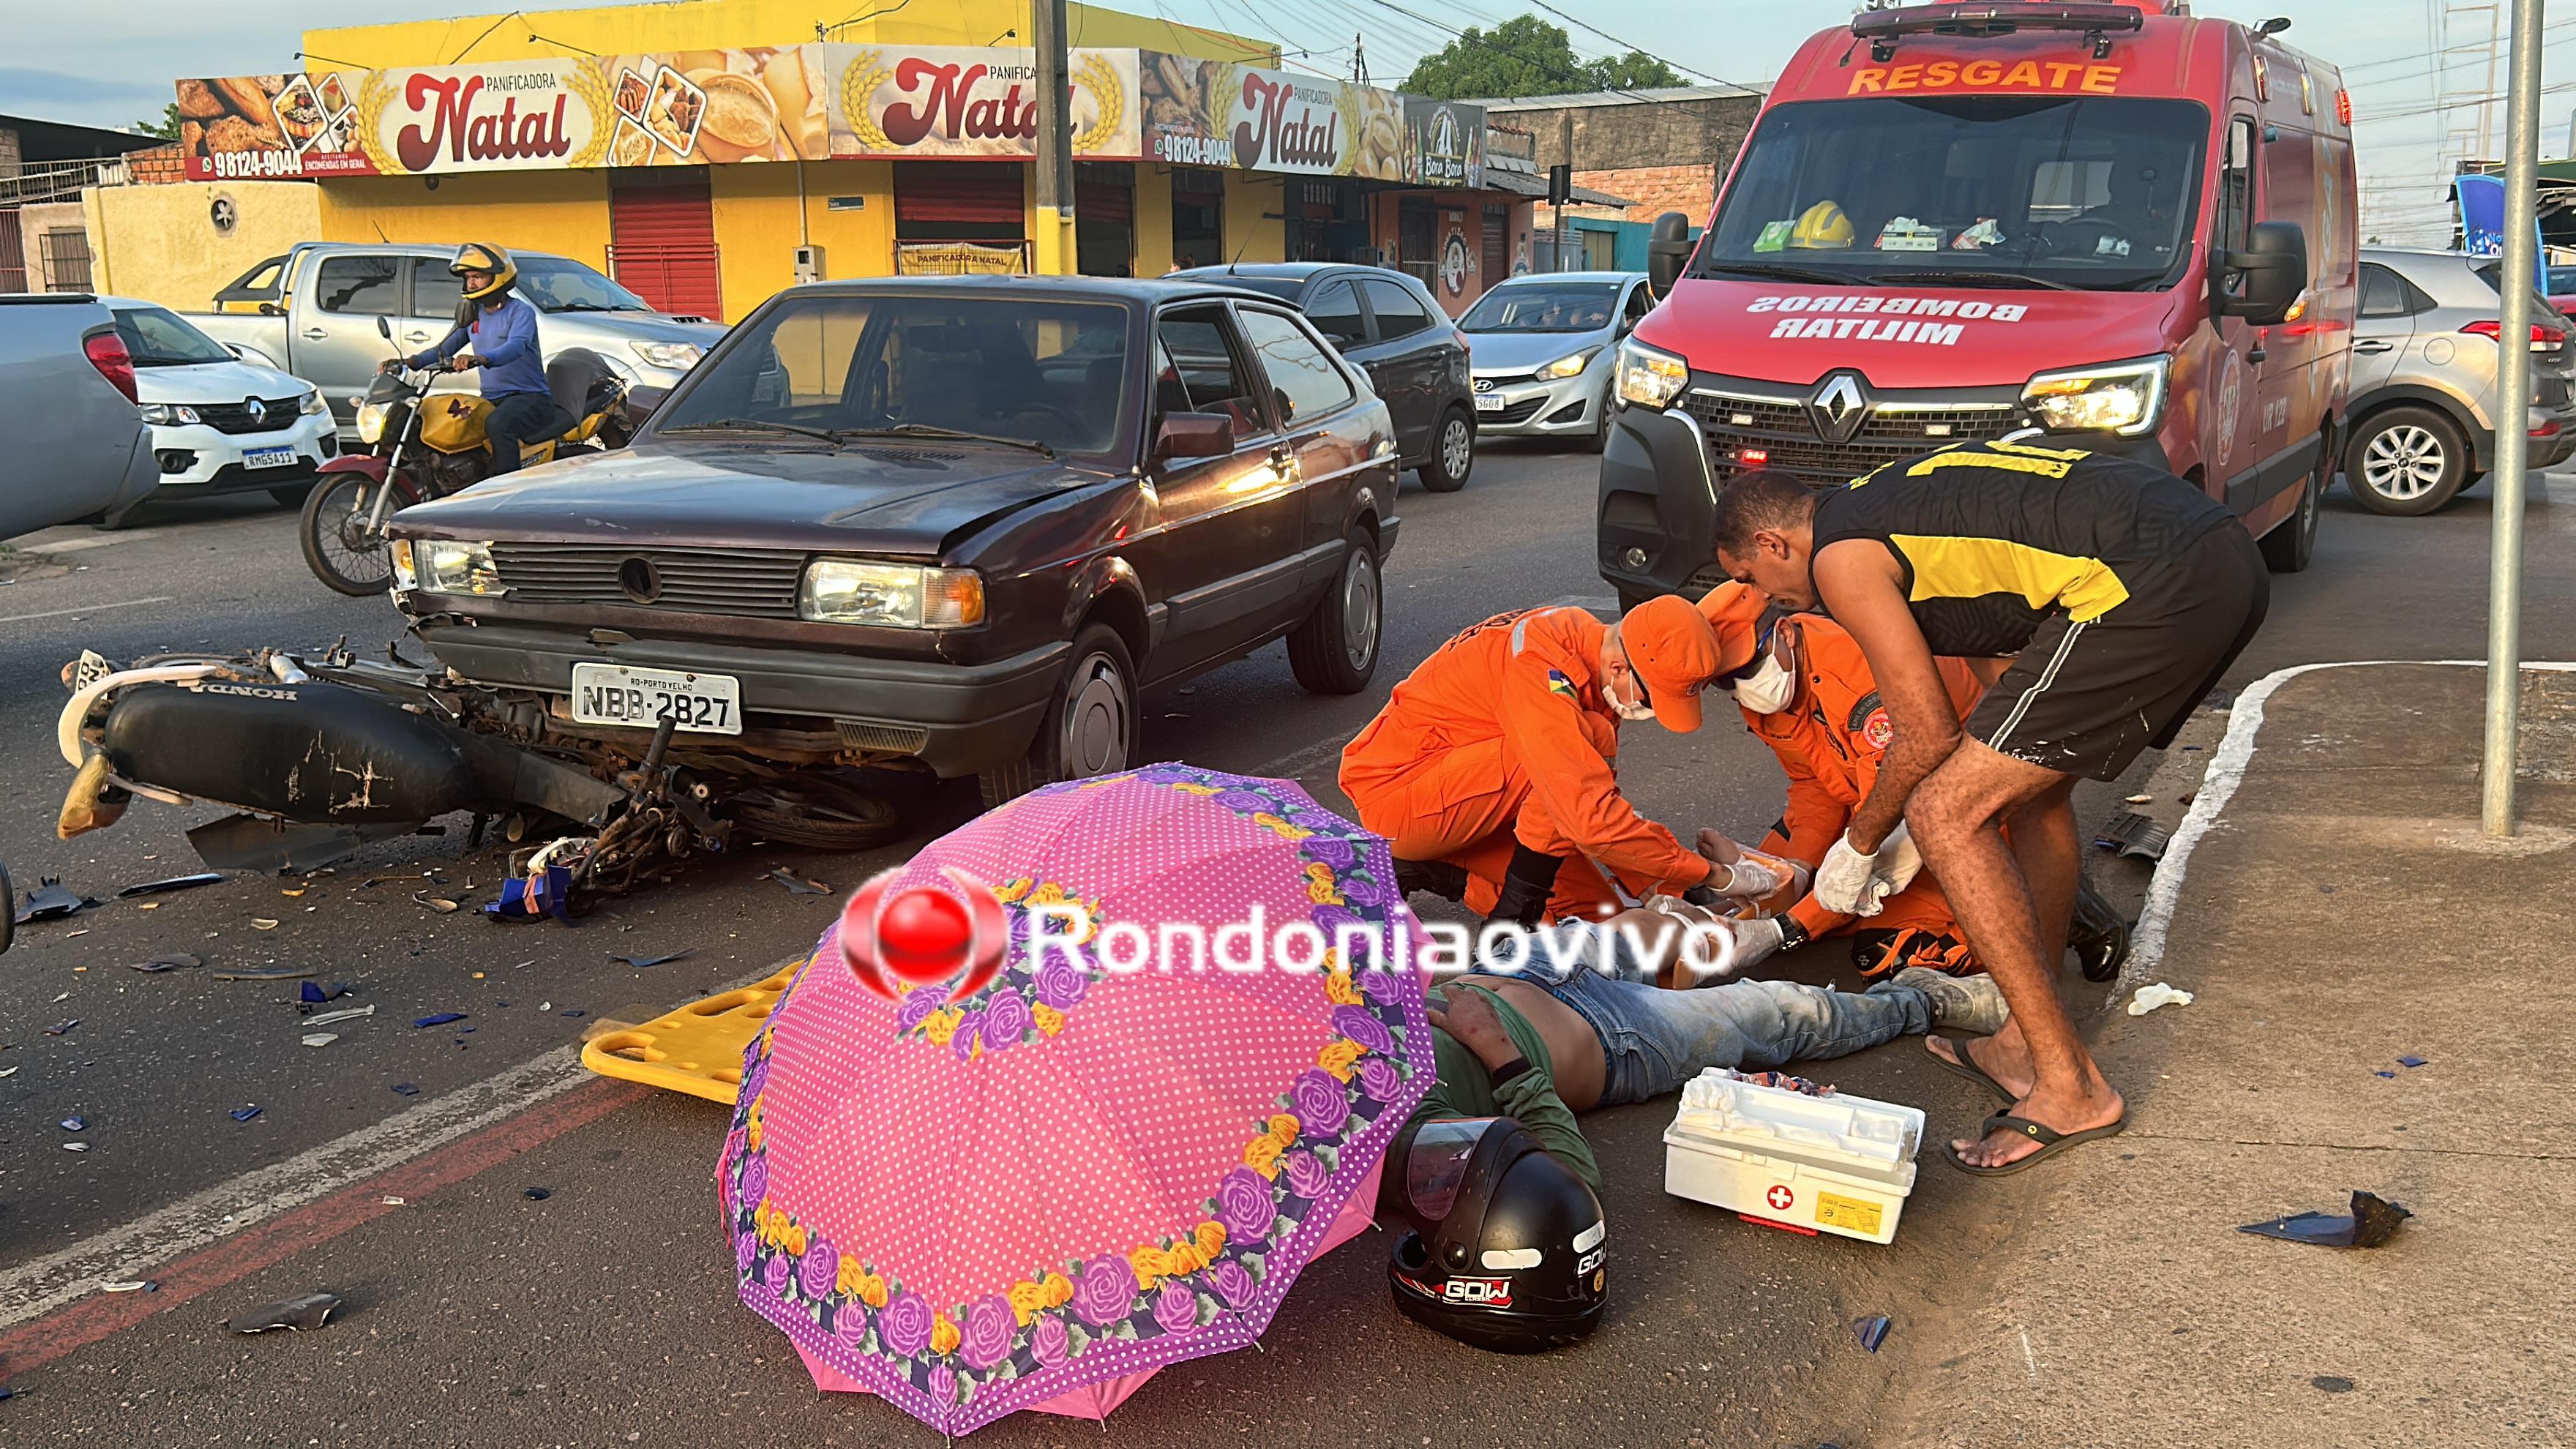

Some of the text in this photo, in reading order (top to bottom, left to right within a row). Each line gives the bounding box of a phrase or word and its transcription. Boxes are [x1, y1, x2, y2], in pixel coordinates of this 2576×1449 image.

[487, 72, 556, 92] PANIFICADORA
[990, 66, 1037, 80] PANIFICA
[1848, 60, 2122, 94] RESGATE
[1294, 86, 1333, 106] PANIFICADORA
[397, 73, 571, 172] Natal
[1234, 72, 1337, 170] Natal
[1164, 135, 1231, 166] 98124-9044
[214, 150, 303, 178] 98124-9044
[304, 158, 366, 171] ENCOMENDAS EM GERAL
[1426, 155, 1462, 179] Bora Bora
[918, 253, 1007, 266] PANIFICADORA NATAL
[248, 452, 293, 468] RMG5A11
[190, 684, 297, 701] HONDA
[667, 683, 693, 692] VELHO
[583, 686, 730, 727] NBB-2827
[1445, 1281, 1510, 1298] GOW
